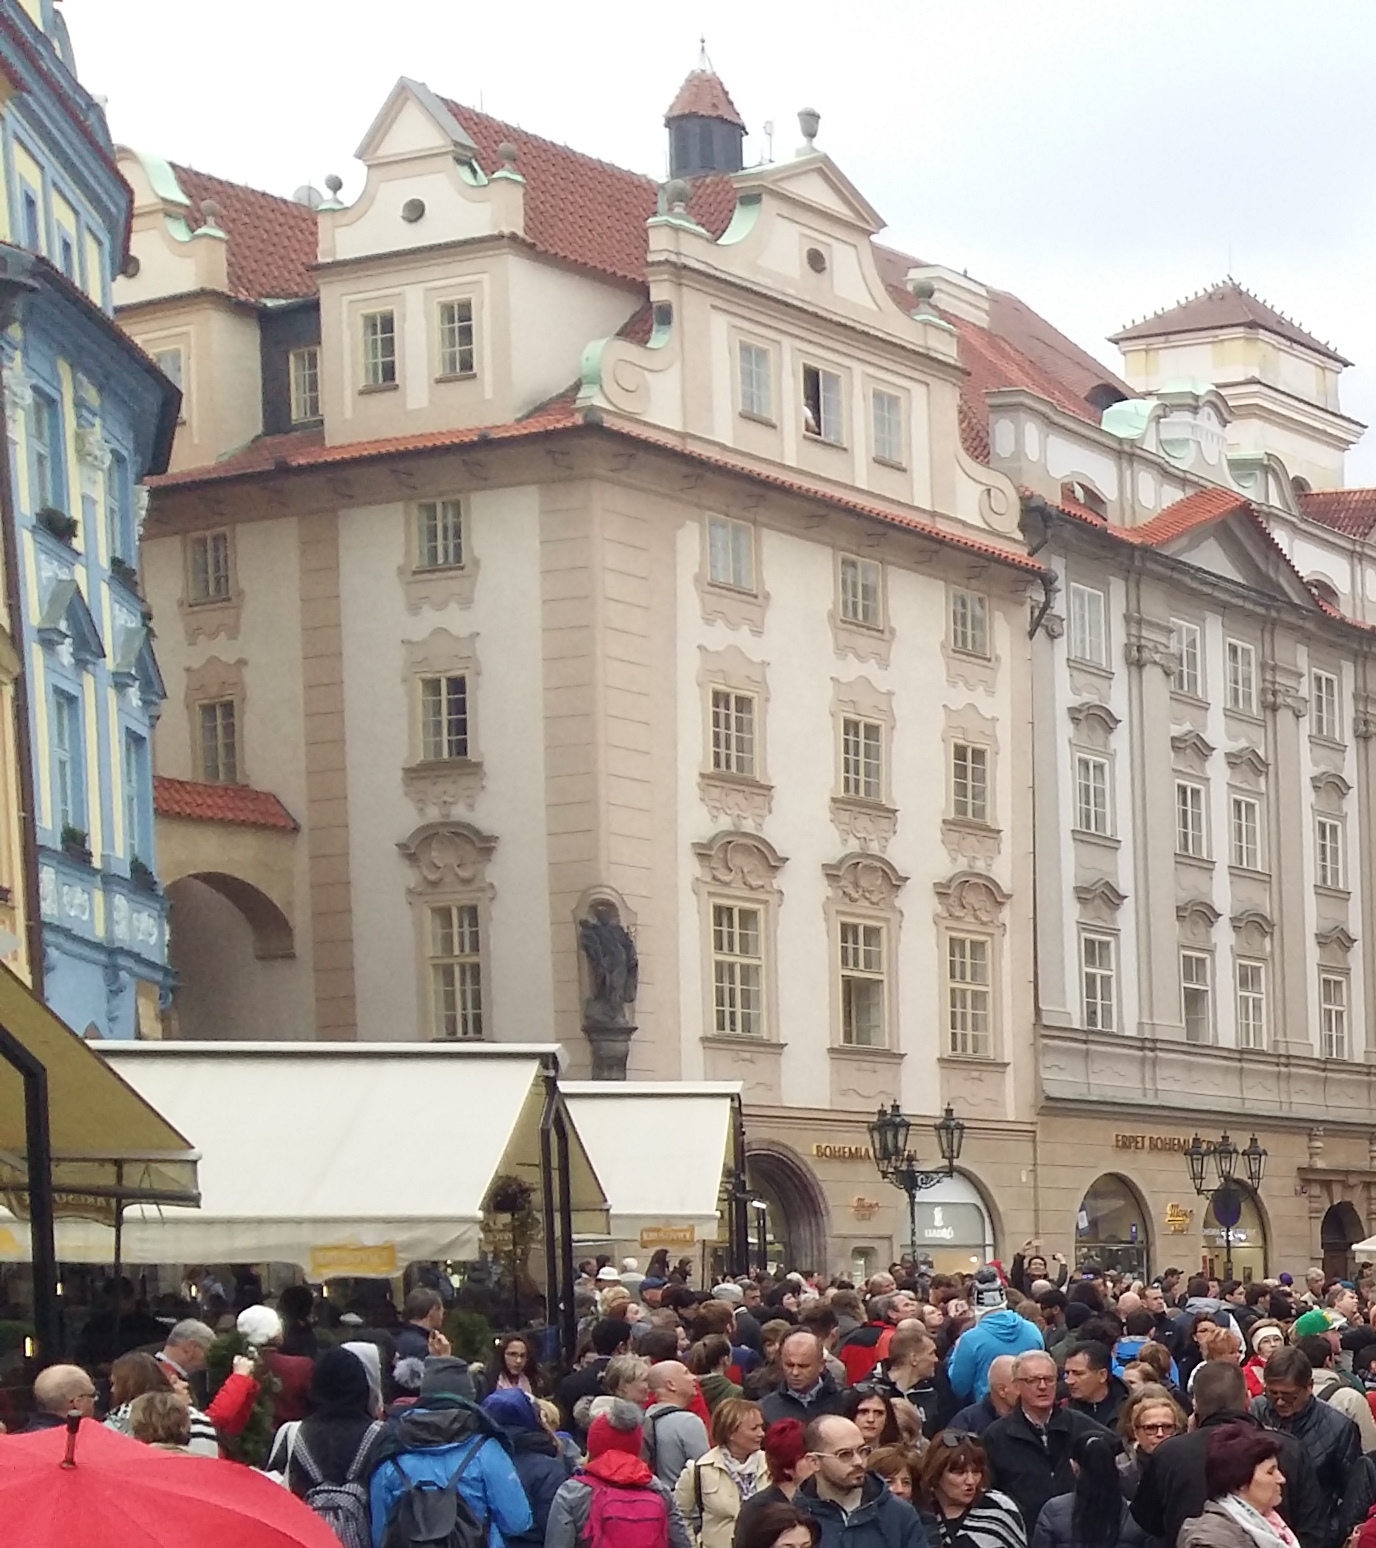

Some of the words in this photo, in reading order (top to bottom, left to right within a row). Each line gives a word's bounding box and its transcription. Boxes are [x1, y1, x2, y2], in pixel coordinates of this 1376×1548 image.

[814, 1144, 871, 1160] BOHEMIA
[1115, 1133, 1146, 1150] ERPET
[1149, 1136, 1190, 1153] BOHEMI
